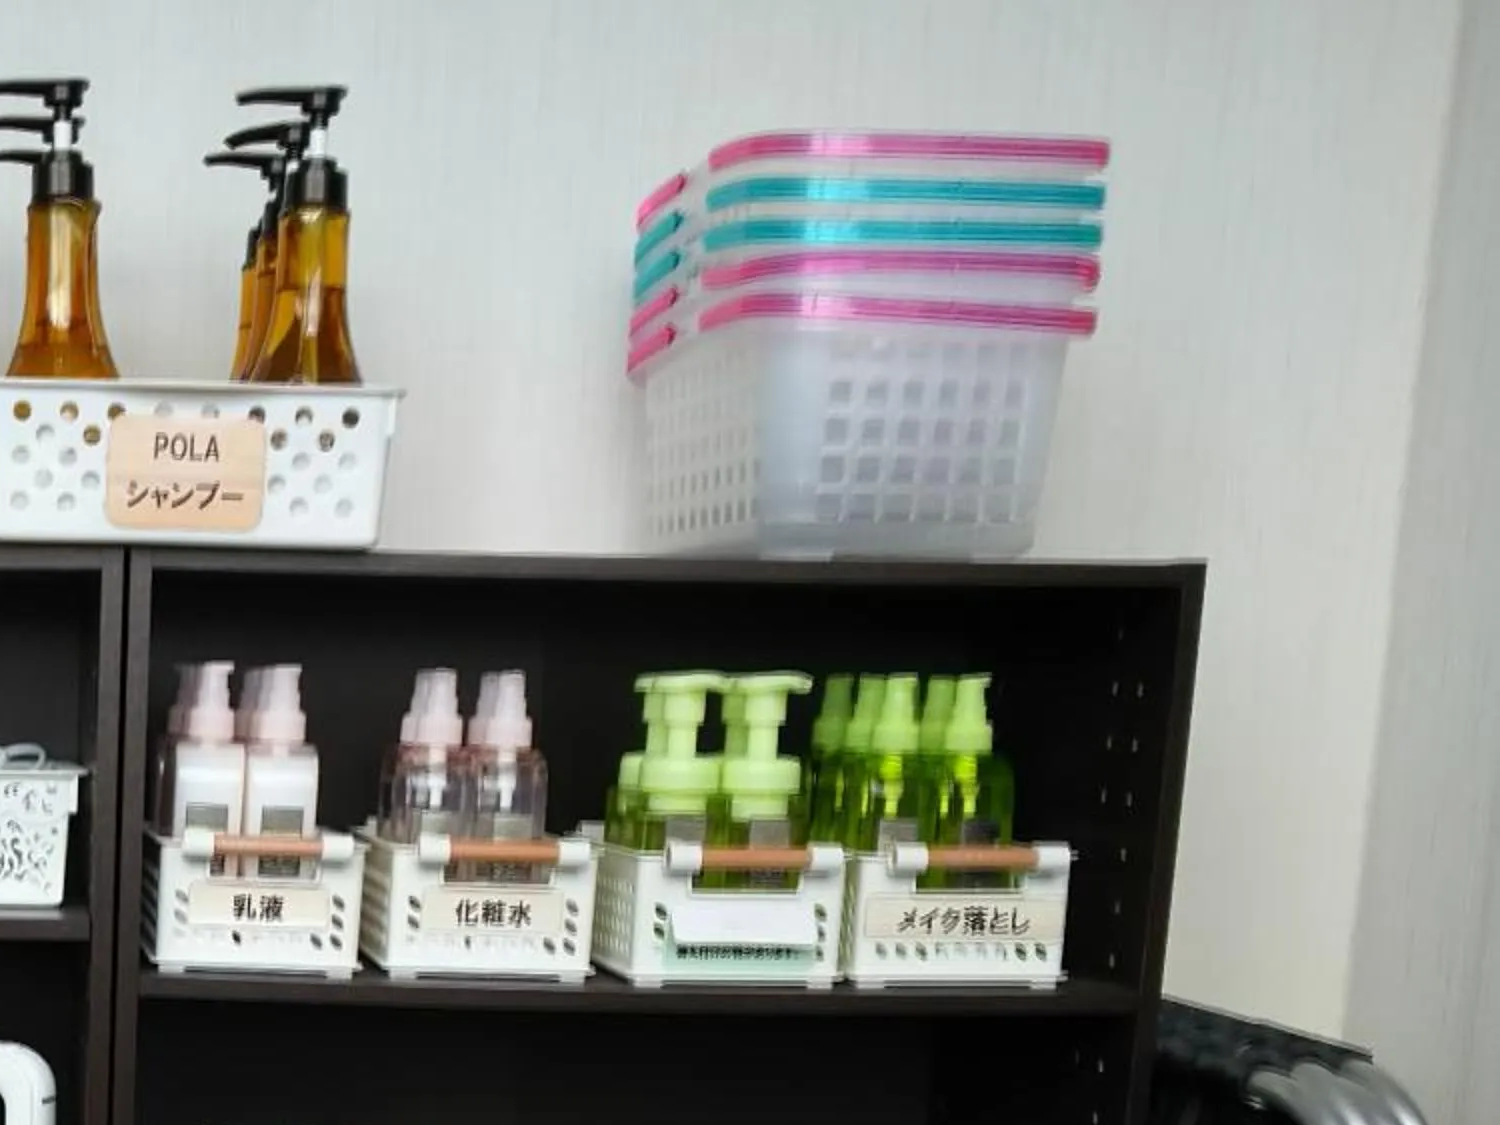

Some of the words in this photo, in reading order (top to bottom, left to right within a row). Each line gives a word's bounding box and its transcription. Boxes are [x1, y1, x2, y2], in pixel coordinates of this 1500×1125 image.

[153, 432, 220, 463] POLA
[126, 480, 244, 510] シャンプー
[233, 892, 283, 921] 乳液
[455, 899, 531, 928] 化粧水
[897, 905, 1030, 936] メイク落とし
